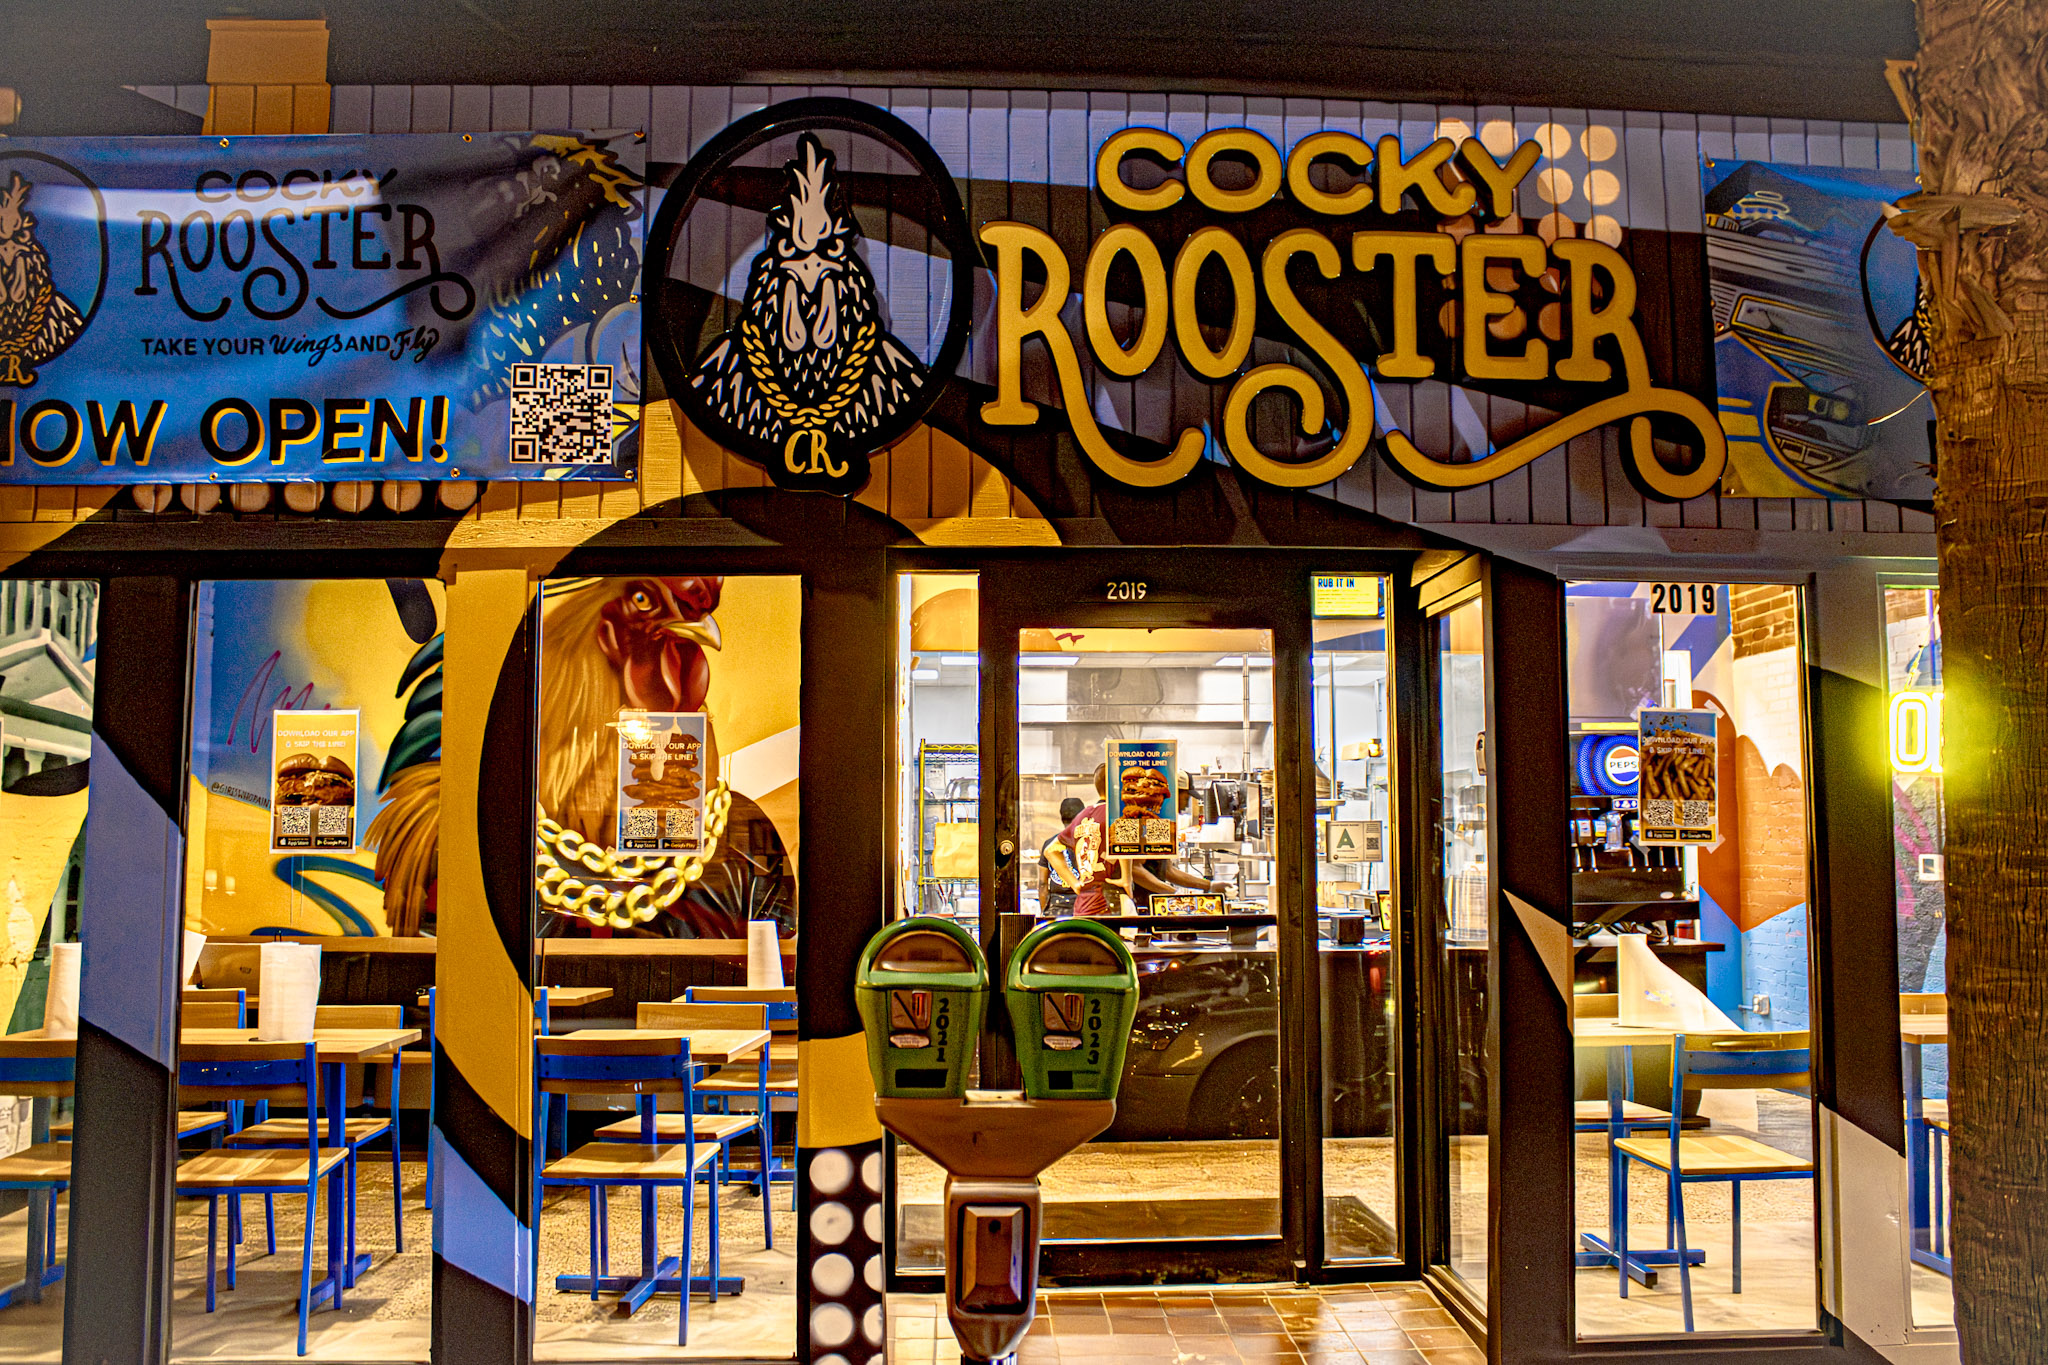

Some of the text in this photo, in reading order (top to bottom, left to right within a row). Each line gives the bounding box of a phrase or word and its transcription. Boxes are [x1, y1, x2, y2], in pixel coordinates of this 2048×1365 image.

[196, 168, 398, 203] COCKY
[1097, 127, 1544, 218] COCKY
[134, 203, 477, 322] ROOSTER
[142, 325, 440, 367] TAKE YOUR Wings AND Fly
[979, 221, 1727, 500] ROOSTER
[0, 354, 35, 385] R
[0, 395, 449, 467] OW OPEN!
[784, 430, 849, 478] CR
[1106, 581, 1148, 600] 2019
[1317, 578, 1355, 588] RUB IT IN
[1652, 583, 1715, 614] 2019
[639, 753, 656, 761] SKIP
[674, 753, 693, 761] LINE!
[668, 742, 685, 750] OUR
[1336, 828, 1356, 848] A
[936, 997, 950, 1063] 2021
[1087, 999, 1101, 1065] 2023
